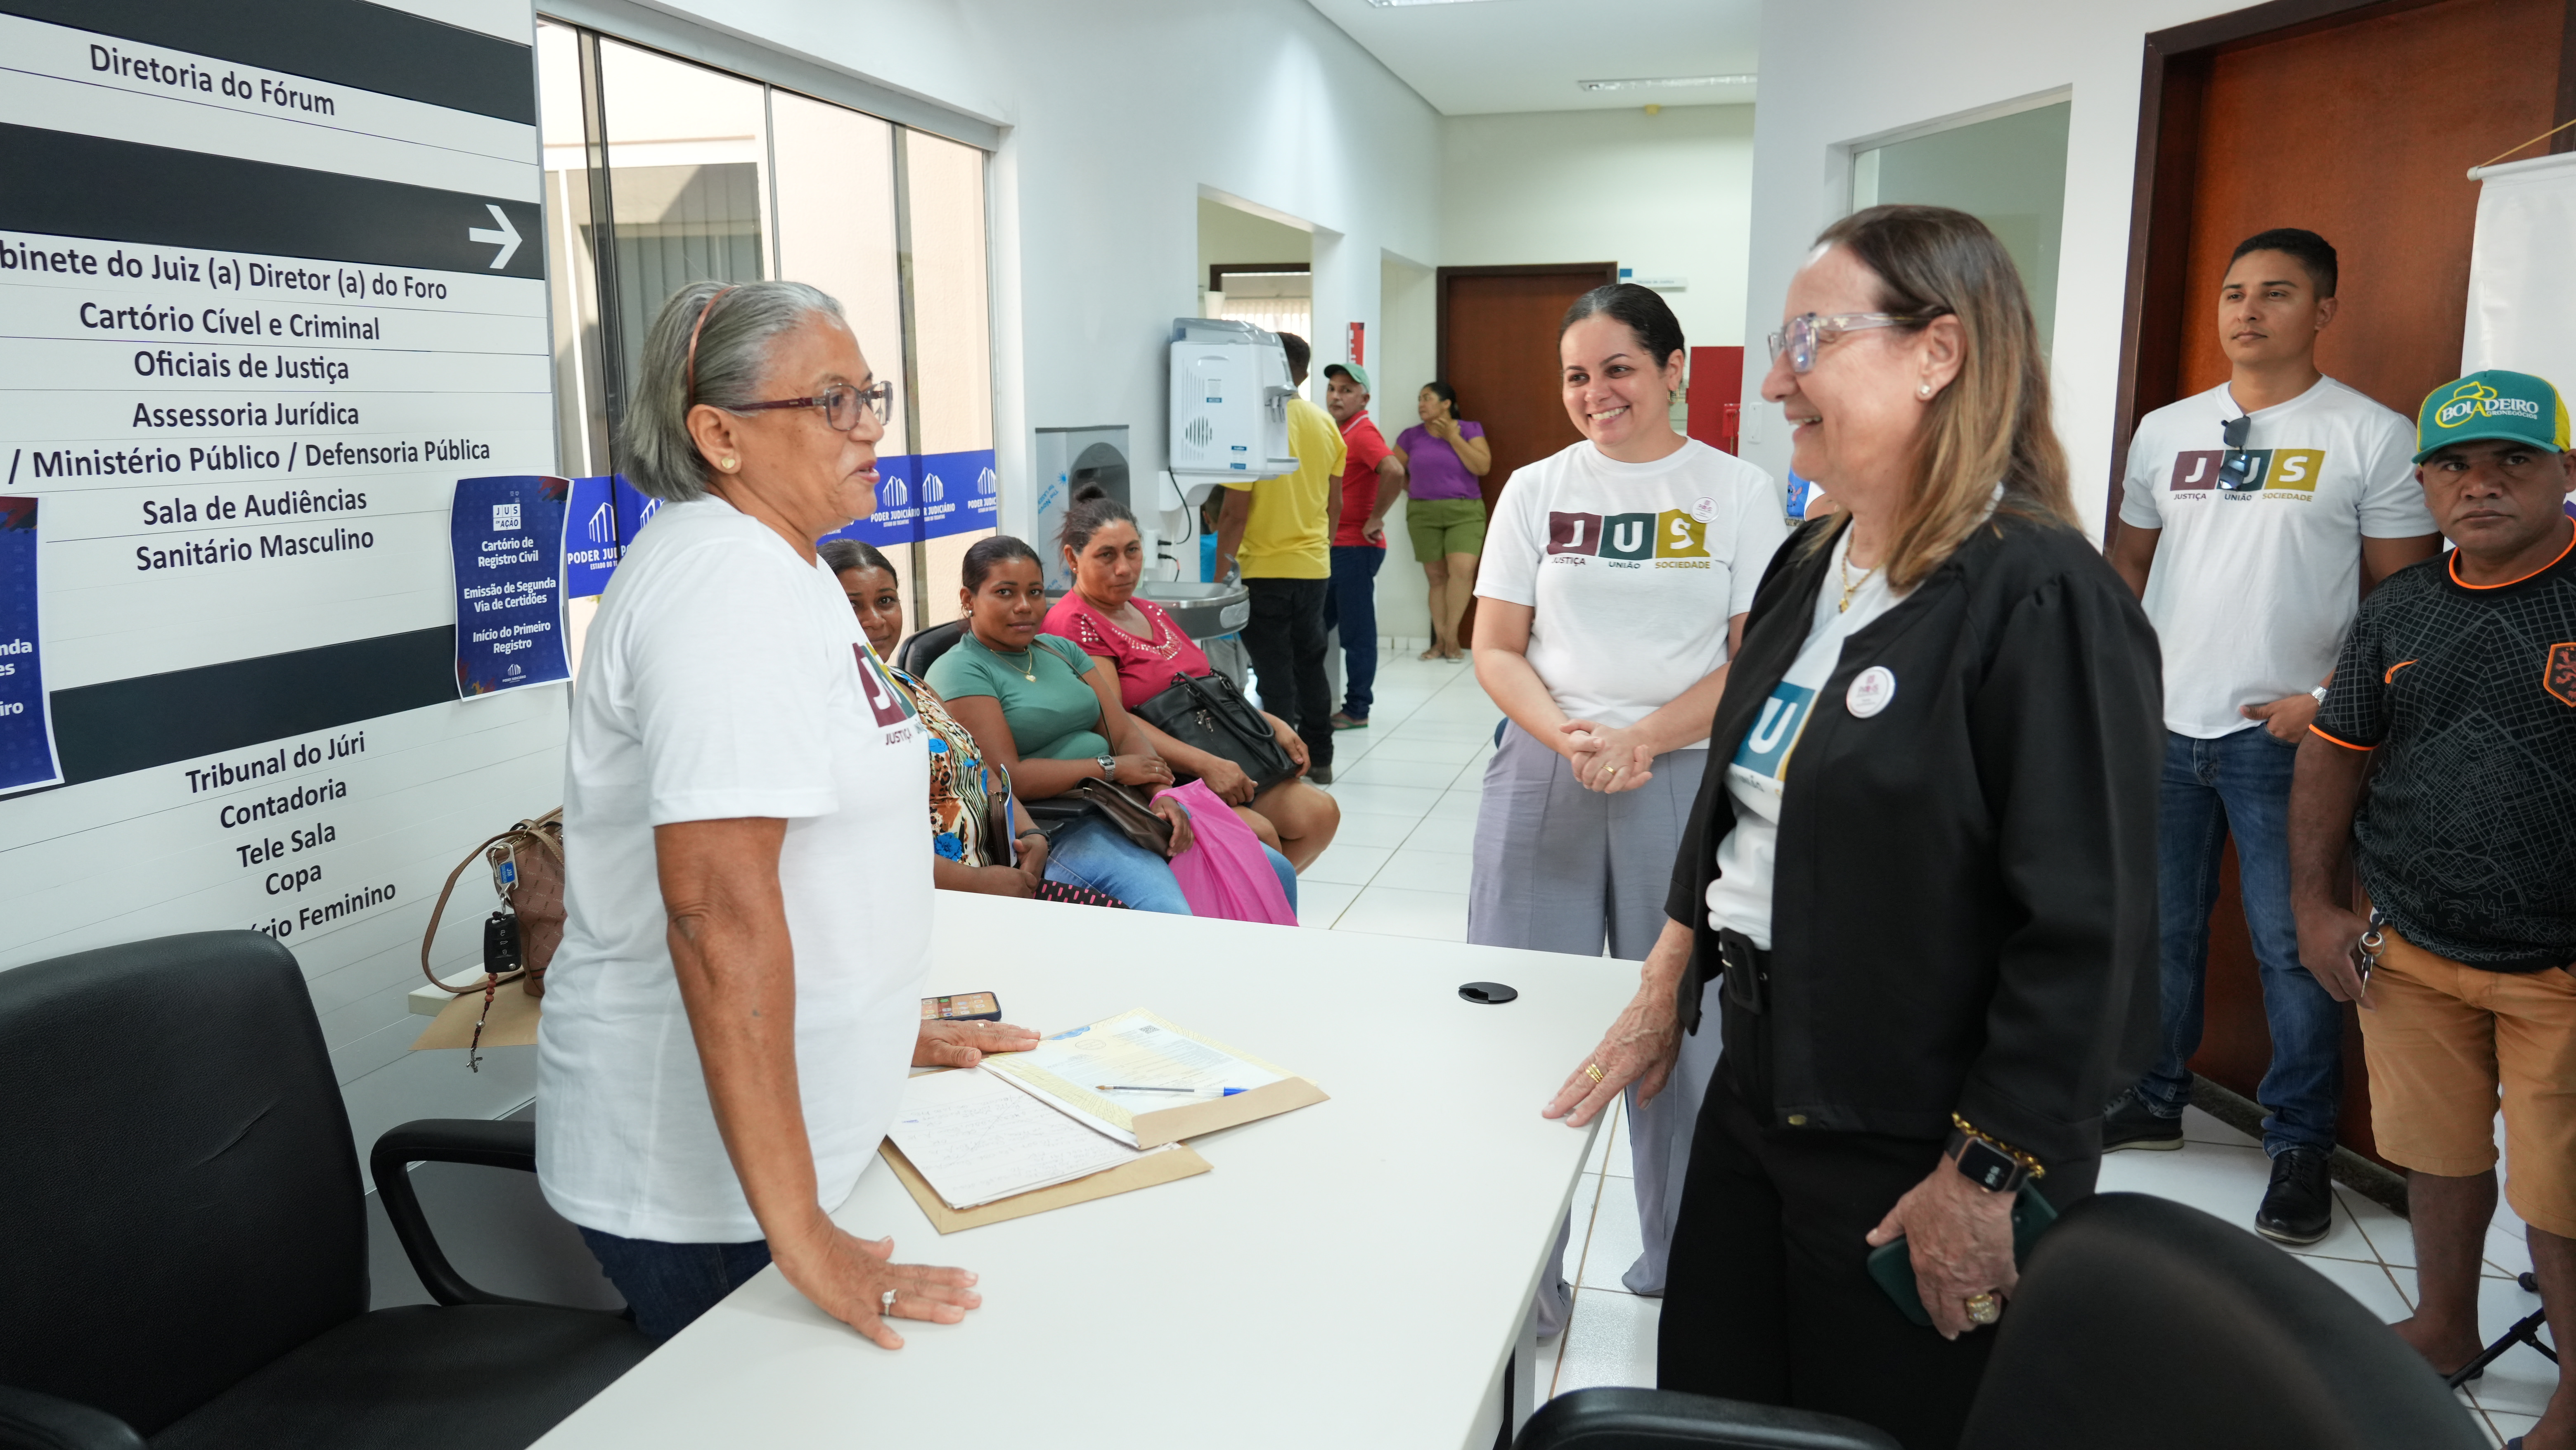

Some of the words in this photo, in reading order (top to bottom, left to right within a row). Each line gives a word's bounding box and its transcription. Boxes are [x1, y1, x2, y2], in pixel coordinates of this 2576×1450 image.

[90, 44, 212, 92] Diretoria
[222, 71, 252, 100] do
[261, 79, 334, 116] Fórum
[108, 250, 142, 278] do
[152, 254, 200, 282] Juiz
[209, 257, 240, 291] (a)
[249, 263, 331, 291] Diretor
[338, 268, 365, 299] (a)
[372, 272, 397, 296] do
[404, 276, 446, 299] Foro
[80, 302, 194, 332] Cartório
[203, 308, 261, 335] Cível
[270, 318, 282, 336] e
[290, 314, 379, 340] Criminal
[135, 350, 230, 377] Oficiais
[239, 353, 268, 378] de
[275, 355, 348, 384] Justiça
[133, 402, 267, 427] Assessoria
[275, 401, 358, 426] Jurídica
[8, 449, 21, 485] /
[33, 447, 180, 478] Ministério
[190, 445, 279, 471] Público
[288, 442, 297, 472] /
[306, 441, 418, 466] Defensoria
[425, 439, 490, 461] Pública
[143, 498, 197, 525] Sala
[206, 495, 236, 521] de
[244, 488, 367, 518] Audiências
[928, 502, 956, 515] JUDICIÁRIO
[968, 499, 983, 509] PODER
[2262, 493, 2313, 502] SOCIEDADE
[500, 518, 519, 529] AÇÃO
[871, 512, 890, 522] PODER
[890, 507, 920, 520] JUDICIÁRIO
[137, 538, 252, 571] Sanitário
[260, 528, 374, 558] Masculino
[481, 538, 520, 552] Cartório
[522, 536, 534, 547] de
[478, 554, 517, 569] Registro
[519, 550, 539, 562] Civil
[568, 550, 600, 564] PODER
[590, 562, 606, 570] ESTADO
[1551, 556, 1586, 566] JUSTIÇA
[1609, 559, 1641, 569] UNIÃO
[1655, 561, 1710, 569] SOCIEDADE
[464, 583, 502, 599] Emissão
[504, 582, 515, 593] de
[516, 577, 556, 593] Segunda
[474, 602, 490, 612] Via
[492, 599, 503, 610] de
[505, 592, 547, 608] Certidões
[473, 629, 498, 642] Início
[500, 626, 512, 638] do
[514, 621, 551, 636] Primeiro
[493, 639, 532, 654] Registro
[185, 749, 286, 793] Tribunal
[294, 744, 321, 768] do
[328, 731, 365, 760] Júri
[220, 778, 346, 828] Contadoria
[236, 838, 284, 867] Tele
[291, 822, 336, 852] Sala
[266, 865, 322, 895] Copa
[299, 881, 395, 931] Feminino
